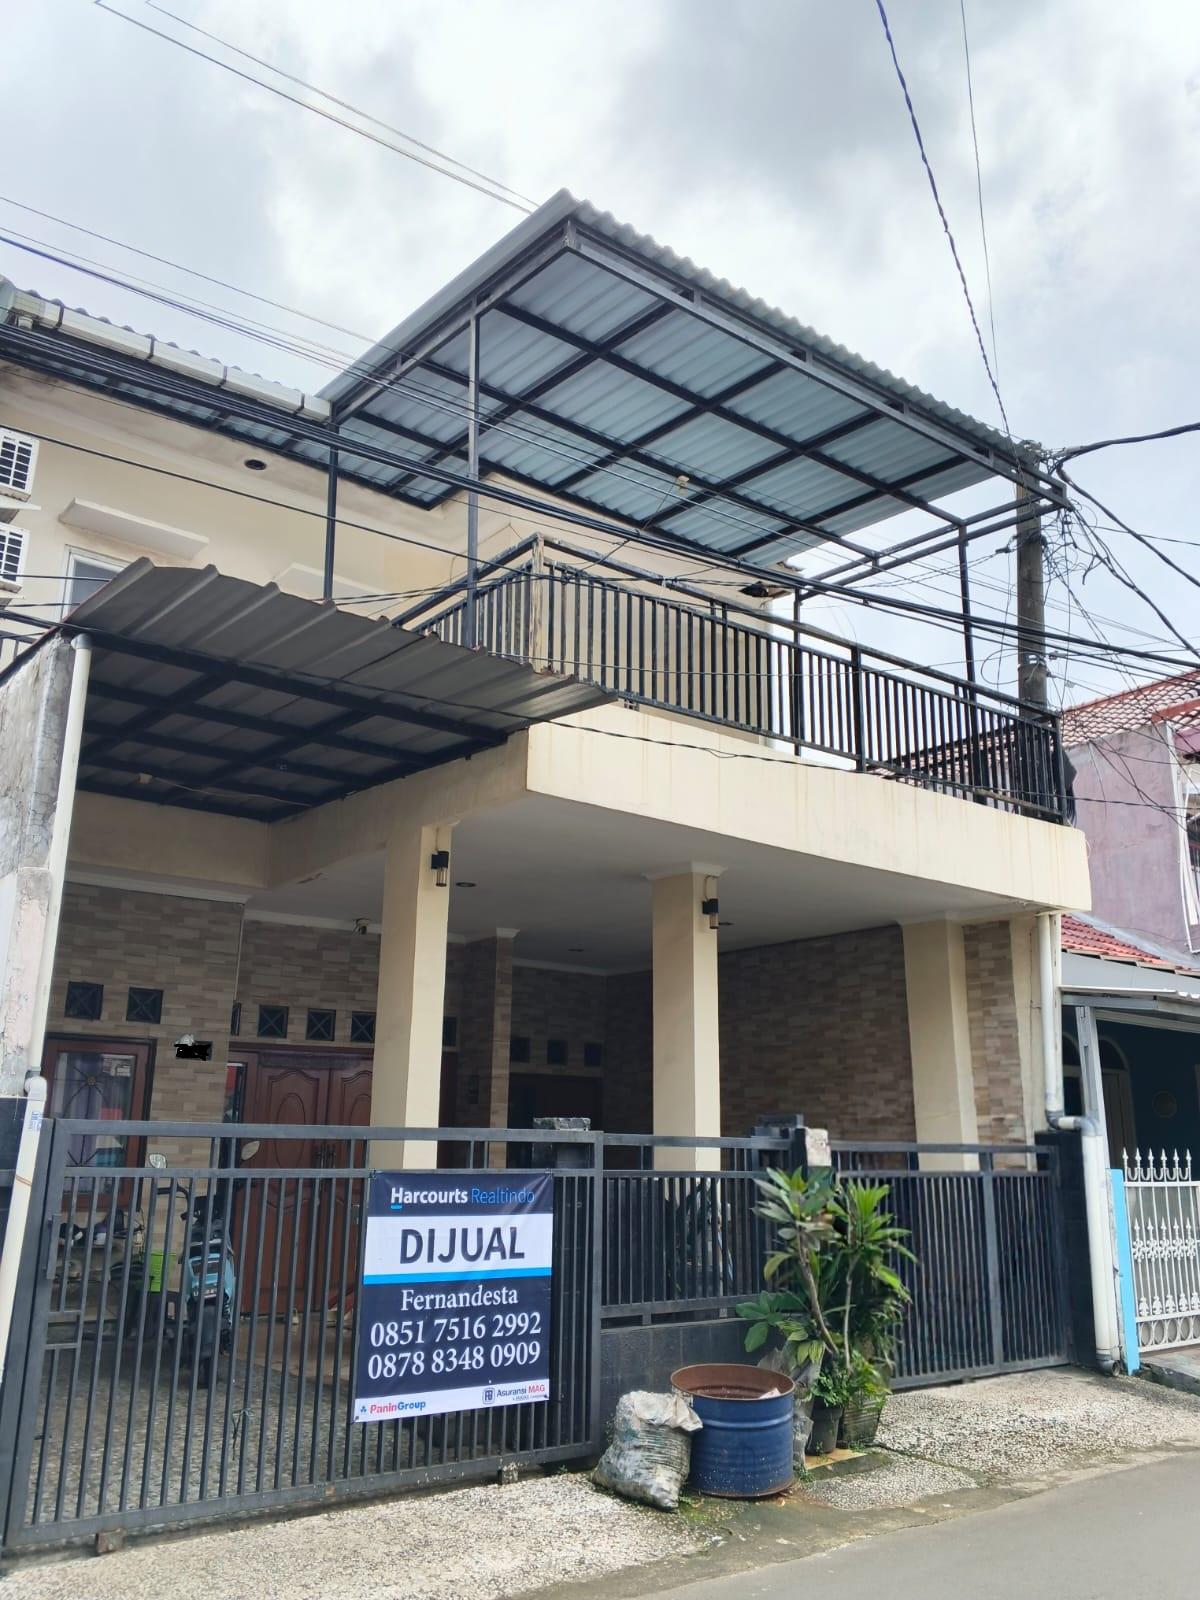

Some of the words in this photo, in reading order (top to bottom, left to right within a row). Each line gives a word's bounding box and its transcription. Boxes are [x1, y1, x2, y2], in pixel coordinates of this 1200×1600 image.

[391, 1187, 468, 1204] Harcourts
[471, 1187, 535, 1204] Realtindo
[400, 1226, 525, 1264] DIJUAL
[401, 1284, 519, 1311] Fernandesta
[370, 1320, 424, 1347] 0851
[434, 1315, 486, 1342] 7516
[492, 1311, 541, 1337] 2992
[368, 1351, 425, 1379] 0878
[431, 1345, 485, 1374] 8348
[490, 1341, 541, 1367] 0909
[497, 1388, 527, 1397] Asuransi
[528, 1384, 545, 1393] MAG
